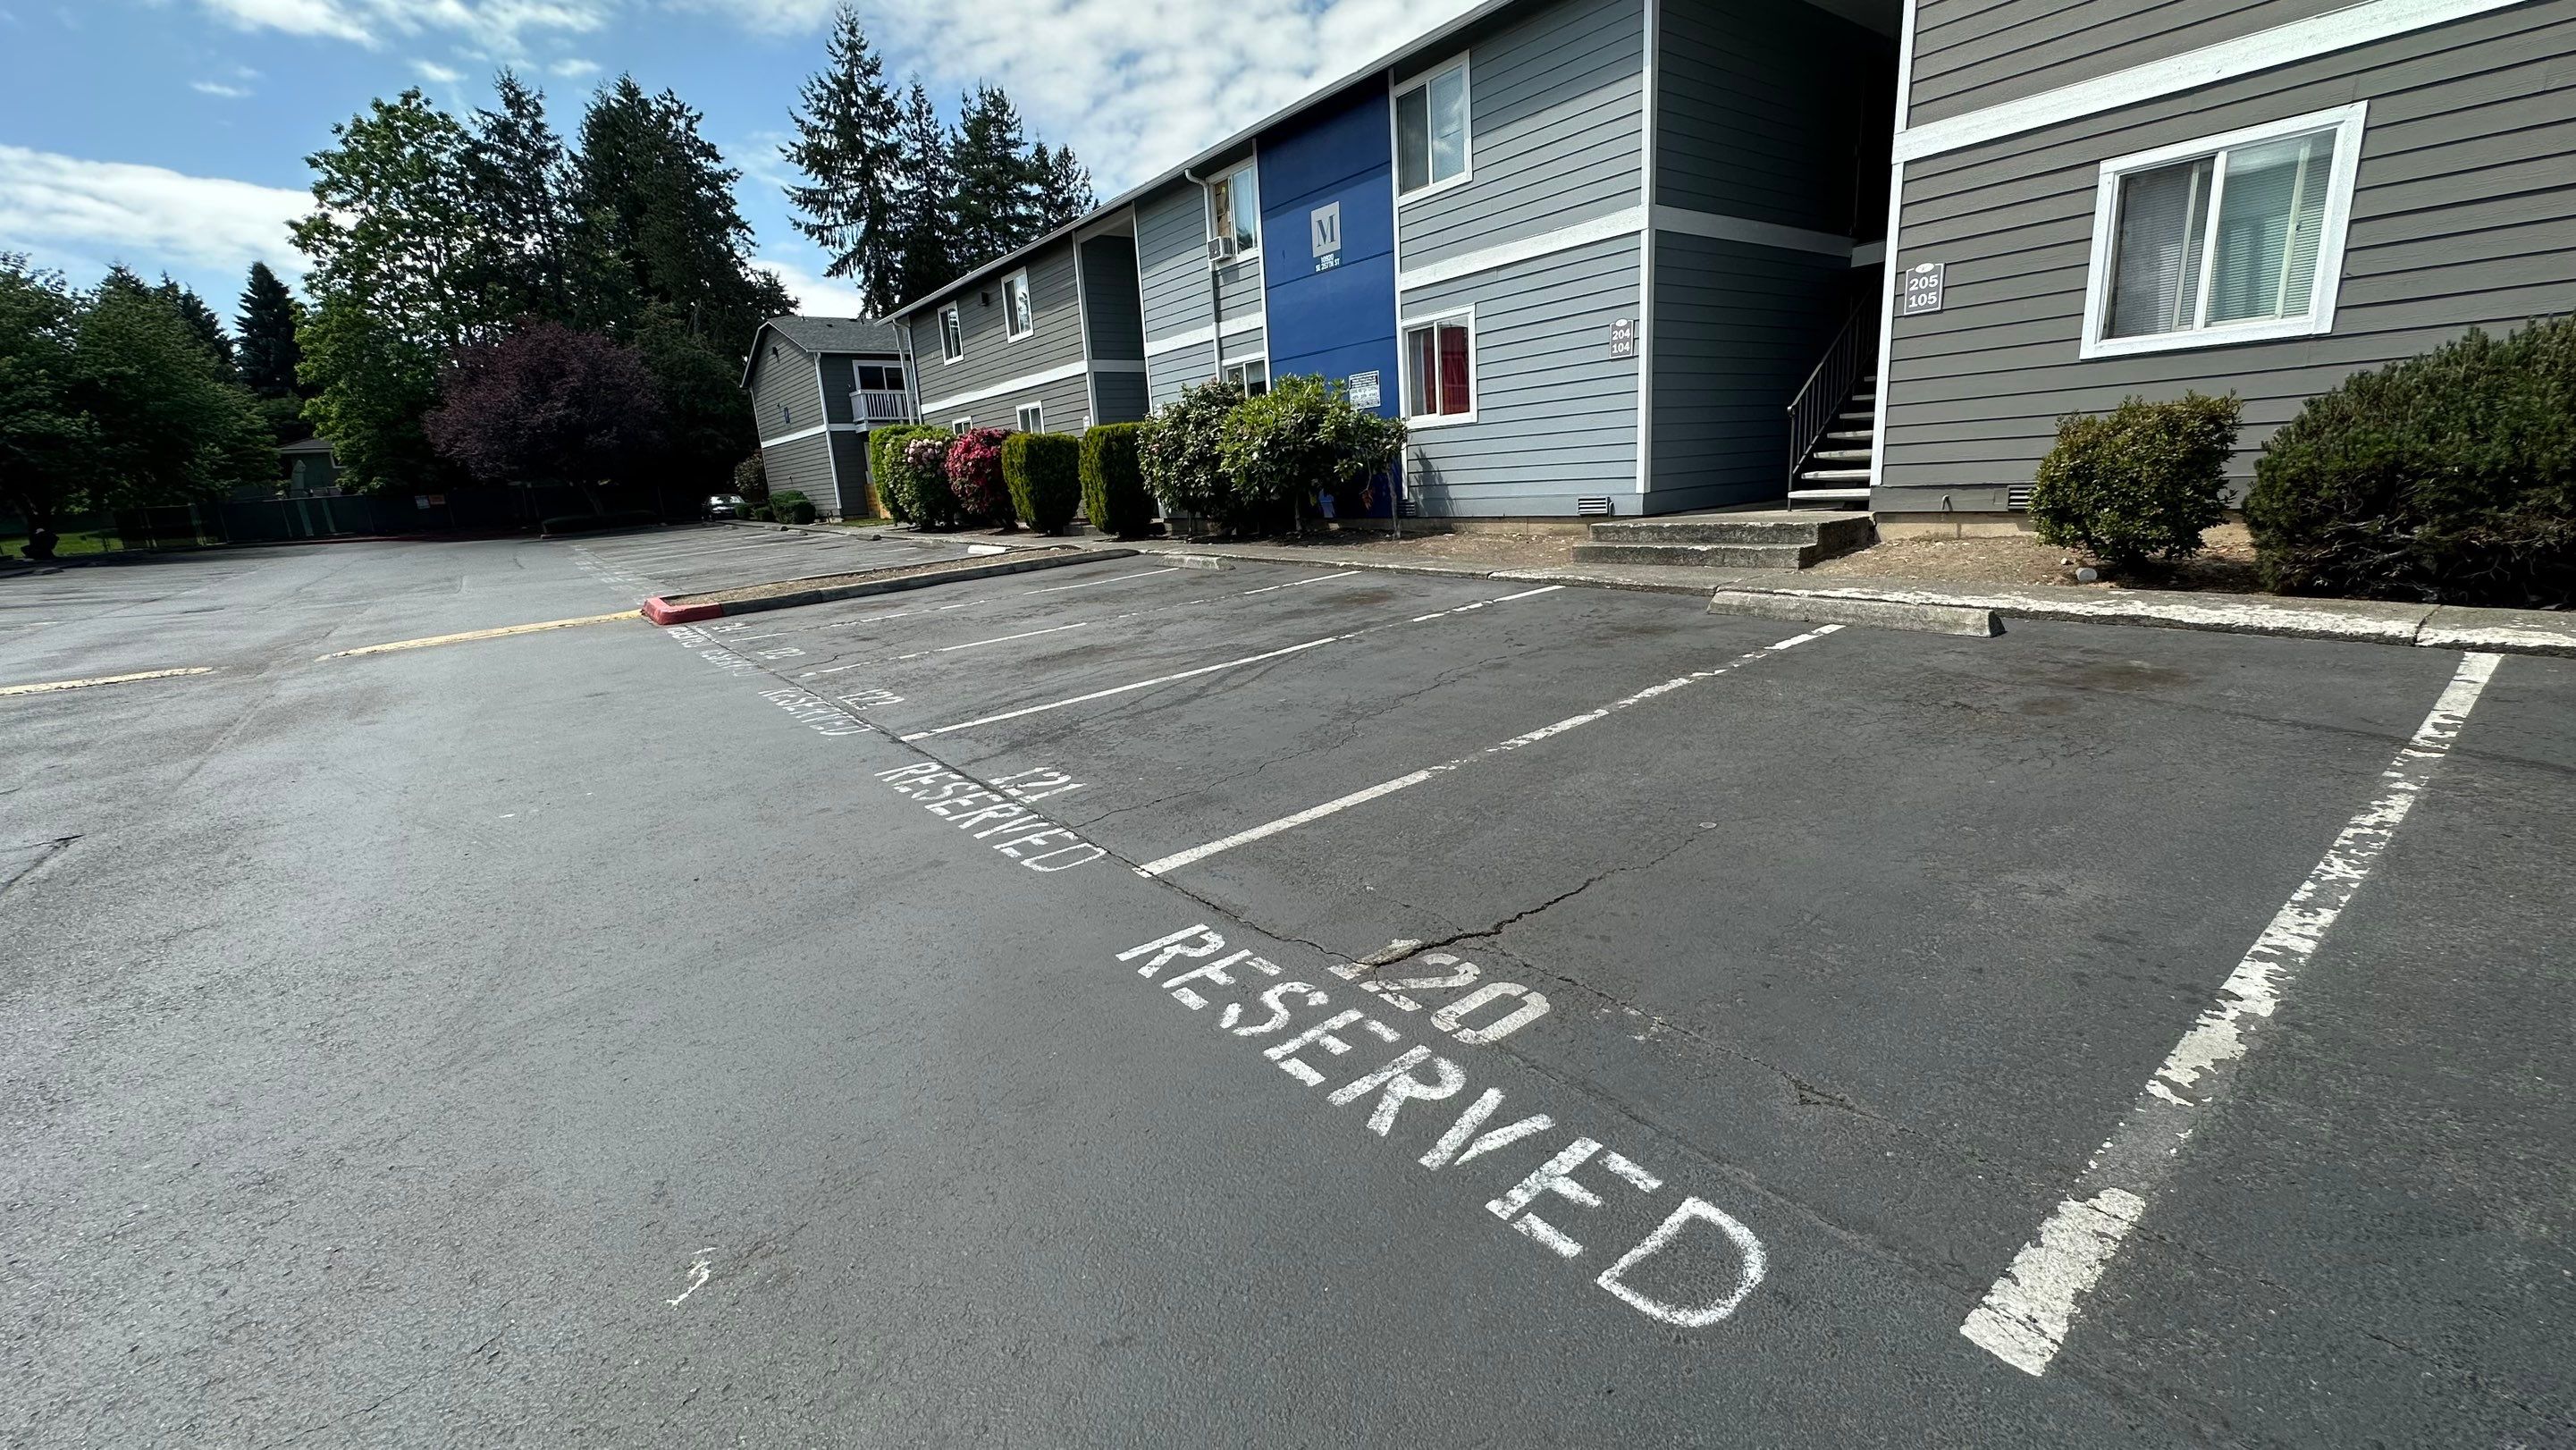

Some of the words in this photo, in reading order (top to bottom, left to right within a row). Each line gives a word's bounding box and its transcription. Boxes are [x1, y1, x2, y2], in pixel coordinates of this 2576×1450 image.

[1316, 214, 1336, 247] M
[1909, 274, 1939, 291] 205
[1908, 291, 1938, 308] 105
[1612, 328, 1630, 340] 204
[1612, 341, 1630, 353] 104
[837, 688, 905, 711] 122
[988, 766, 1088, 804] 121
[873, 762, 1107, 873] RESERVED
[1327, 938, 1551, 1046] 120
[1115, 923, 1768, 1328] RESERVED
